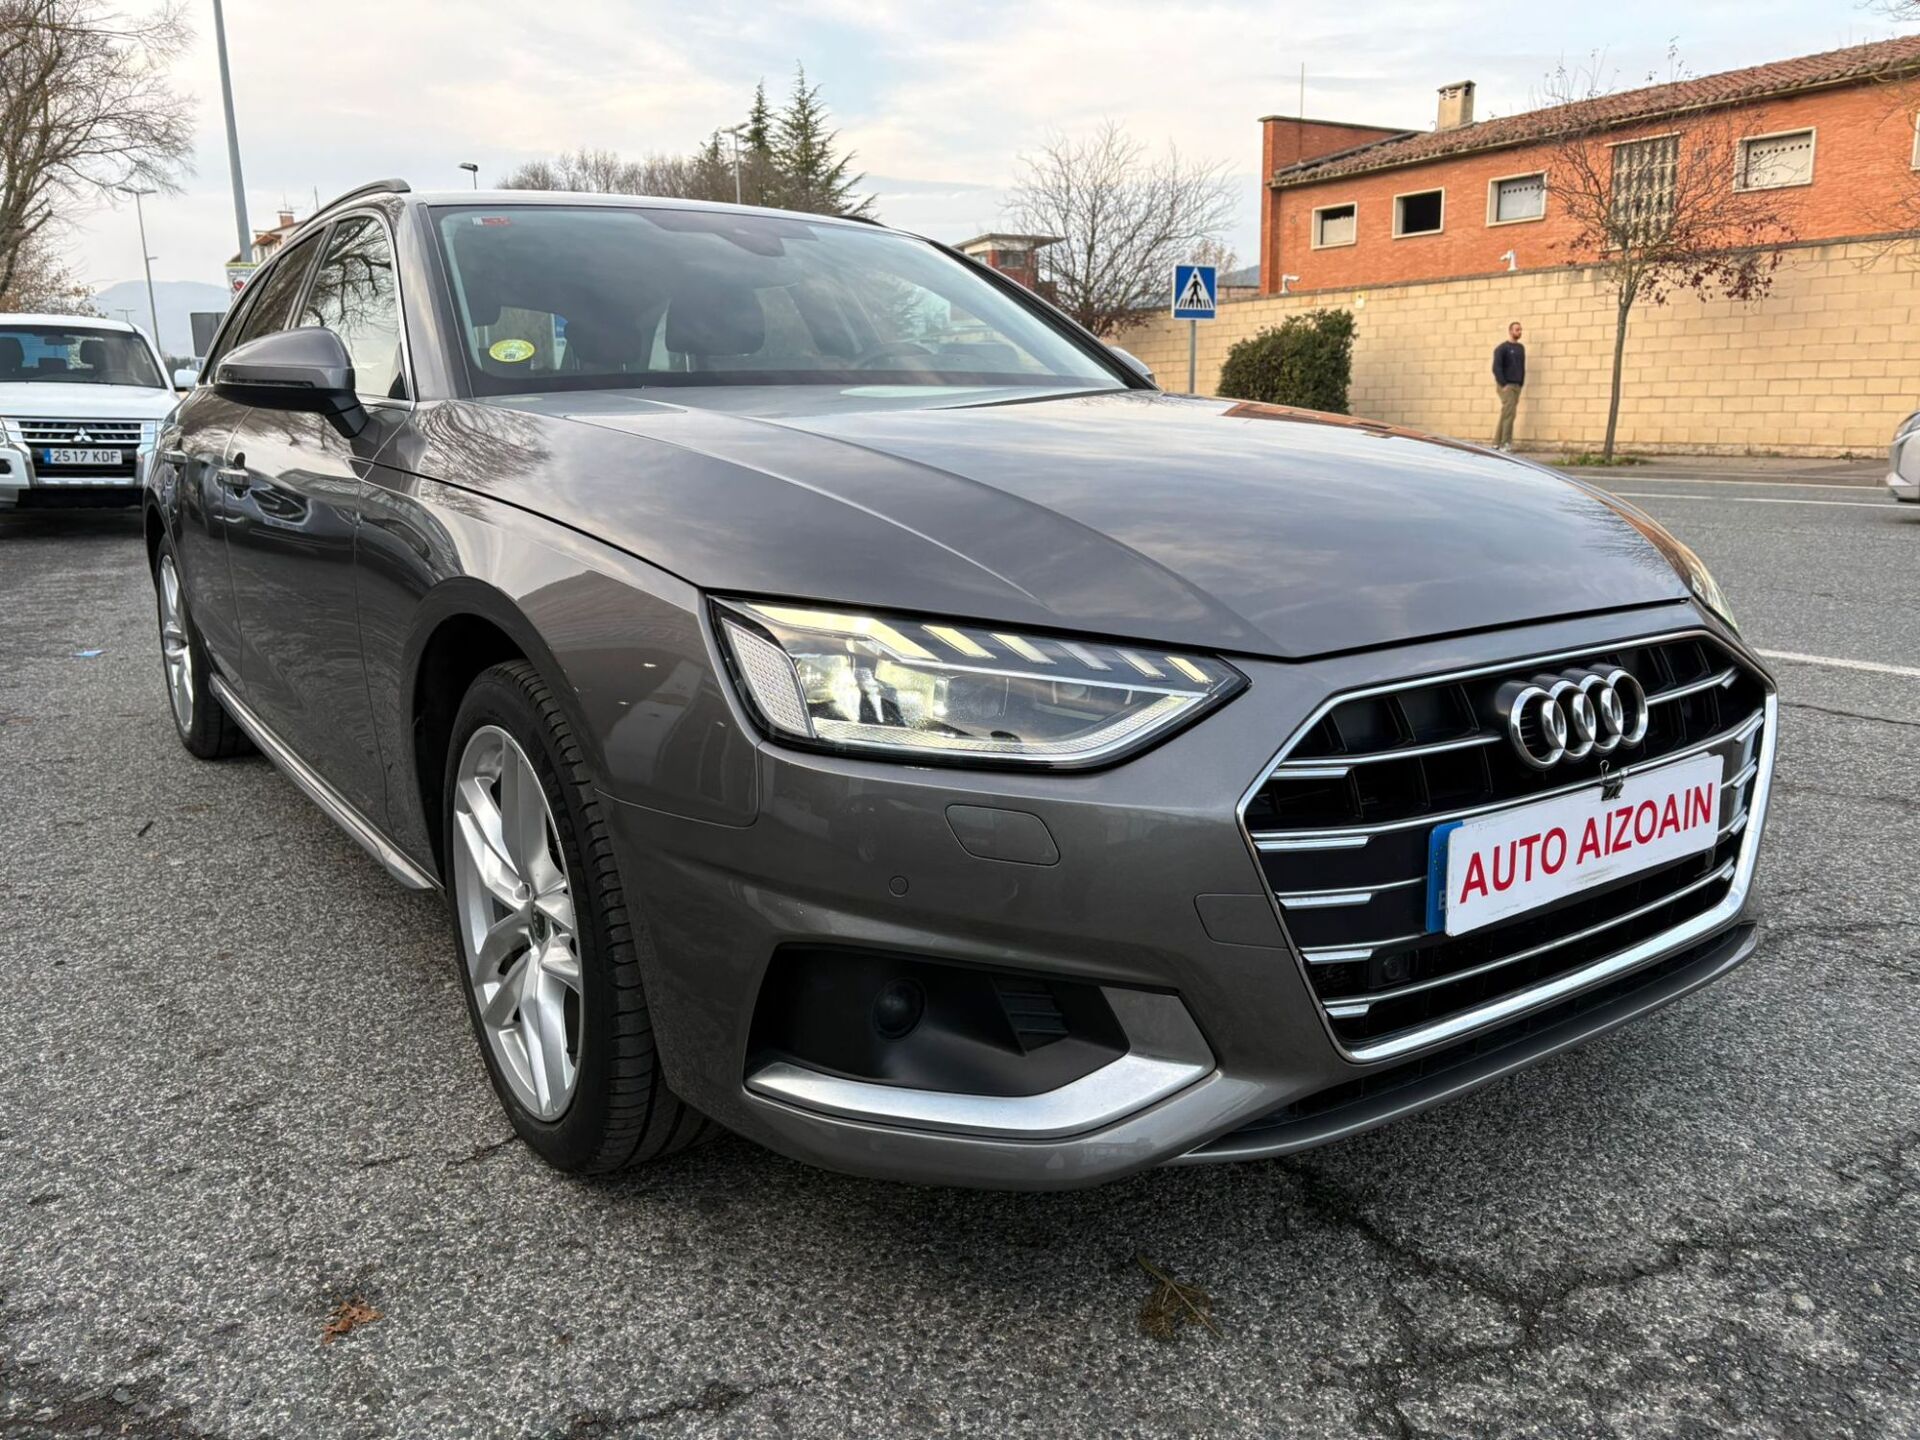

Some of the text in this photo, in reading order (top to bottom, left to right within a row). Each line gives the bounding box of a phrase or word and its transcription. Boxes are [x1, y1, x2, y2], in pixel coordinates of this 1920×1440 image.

[54, 450, 118, 462] 2517 KDF
[1459, 782, 1714, 904] AUTO AIZOAIN
